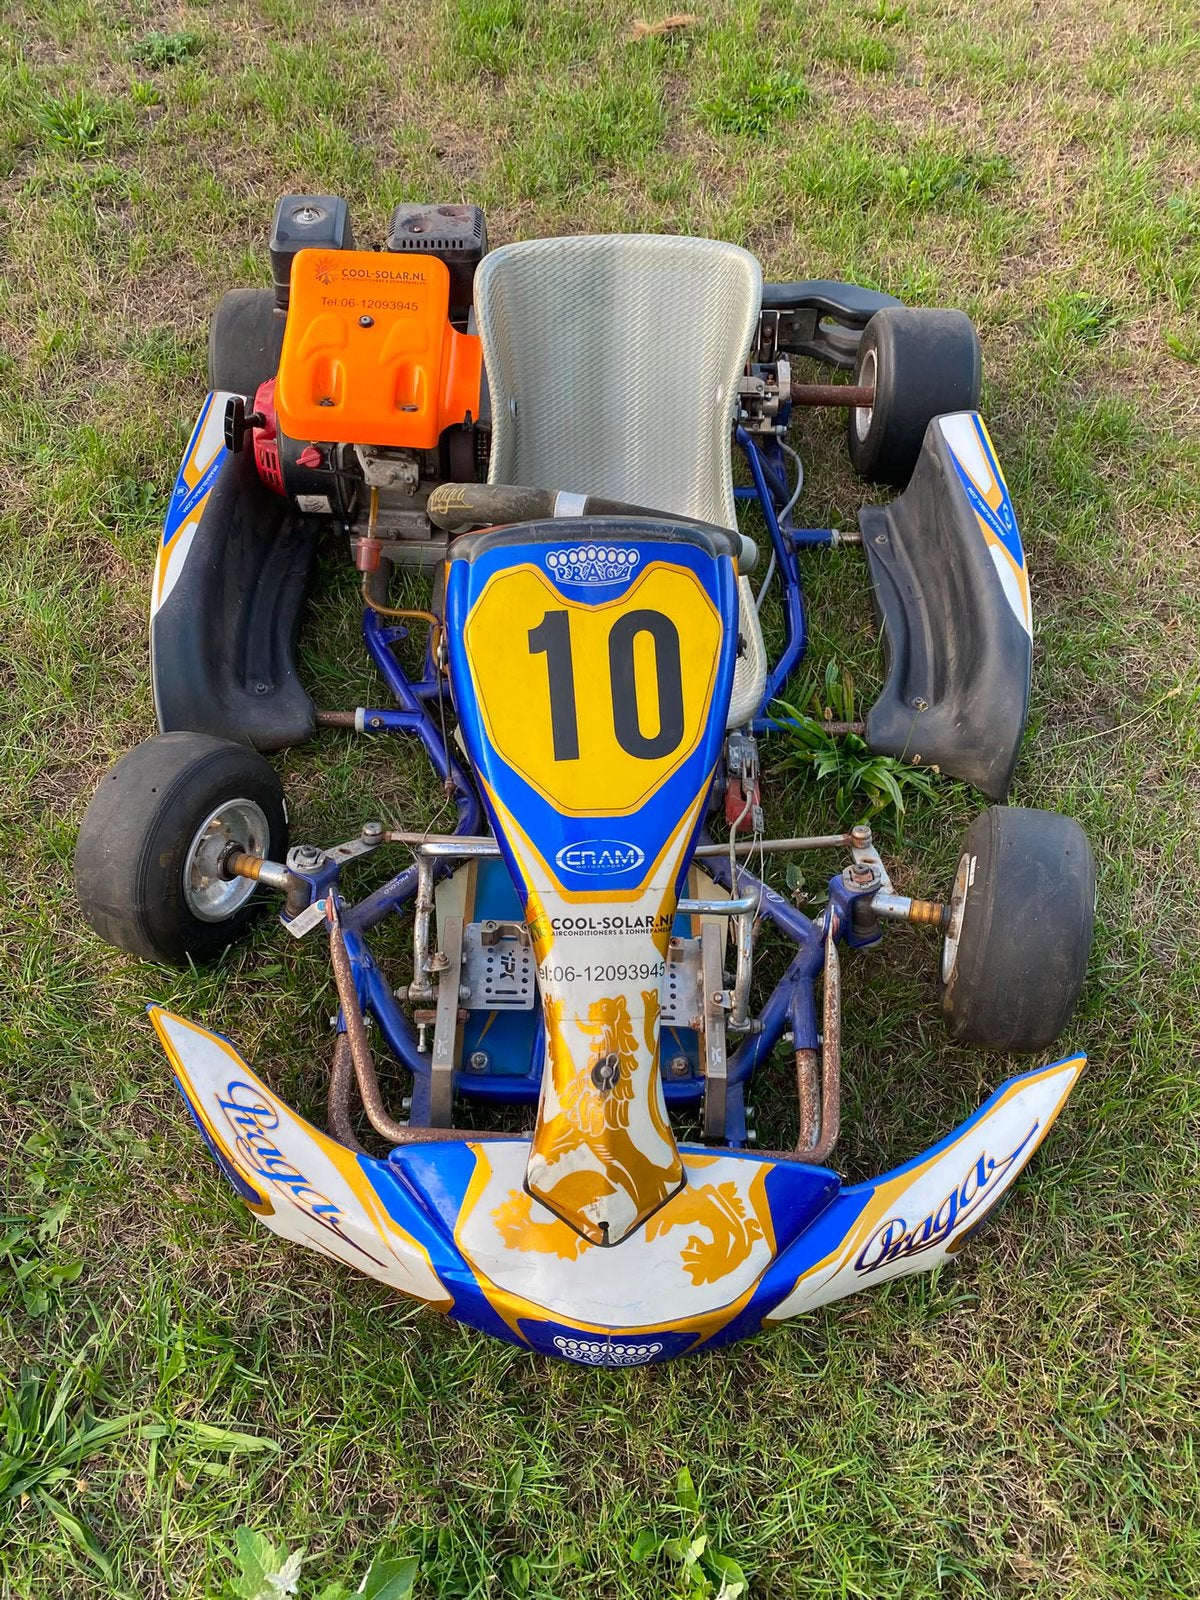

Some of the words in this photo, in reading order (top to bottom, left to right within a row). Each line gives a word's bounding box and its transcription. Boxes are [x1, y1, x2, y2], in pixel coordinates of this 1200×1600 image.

[341, 269, 426, 281] COOL-SOLAR.NL
[321, 296, 419, 312] Tel:06-12093945
[527, 609, 685, 761] 10
[566, 849, 635, 866] CRAM
[538, 961, 665, 982] el:06-12093945
[213, 1080, 372, 1246] Praga
[854, 1132, 1020, 1278] Praga
